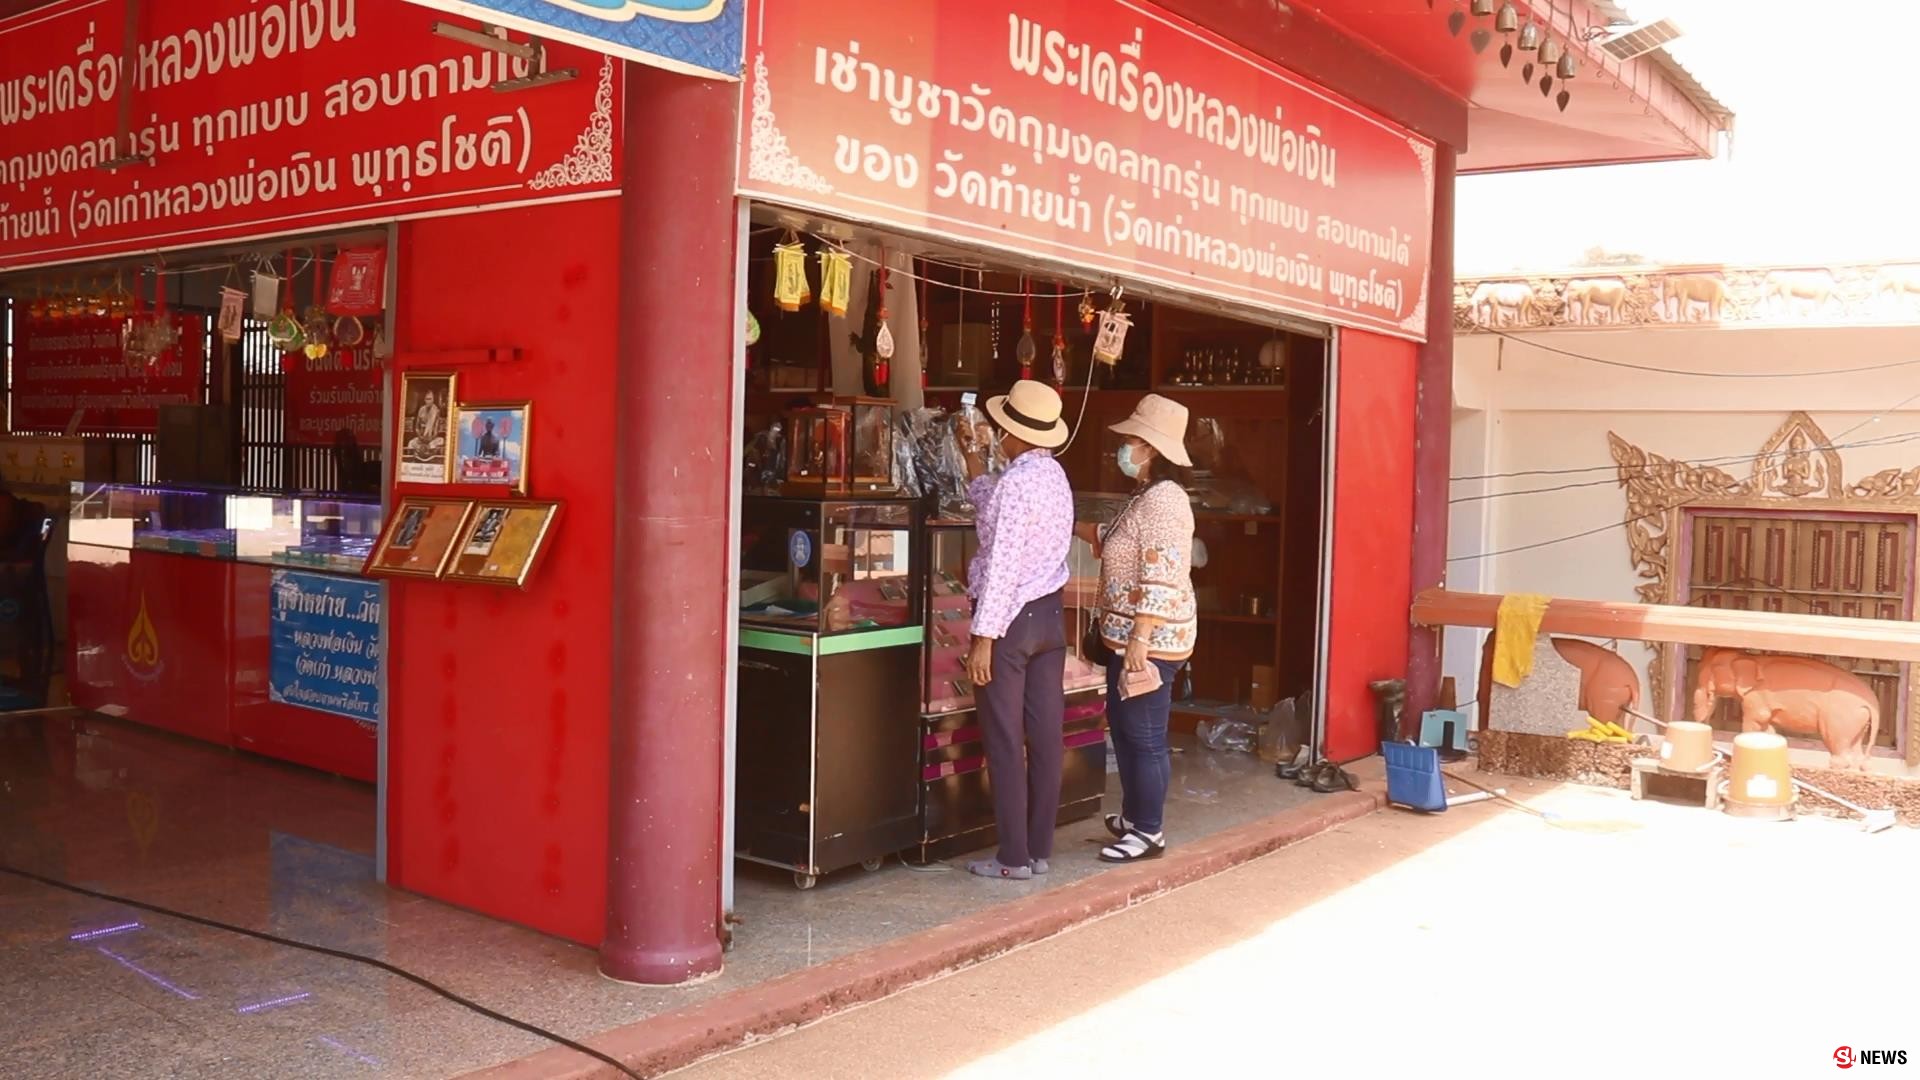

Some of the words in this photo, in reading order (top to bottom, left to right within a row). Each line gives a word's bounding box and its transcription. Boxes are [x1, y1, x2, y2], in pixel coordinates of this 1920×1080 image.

[193, 91, 308, 156] ทุกแบบ
[814, 40, 1221, 211] เช่าบูชาวัตถุมงคลทุกรุ่น
[1230, 184, 1309, 233] ทุกแบบ
[1316, 215, 1412, 267] สอบถามได้
[1009, 13, 1336, 188] พระเครื่องหลวงพ่อเงิน
[70, 151, 337, 238] (วัดเก่าหลวงพ่อเงิน
[834, 134, 919, 189] ของ
[934, 149, 1091, 233] วัดท้ายน้ำ
[1103, 193, 1322, 291] (วัดเก่าหลวงพ่อเงิน
